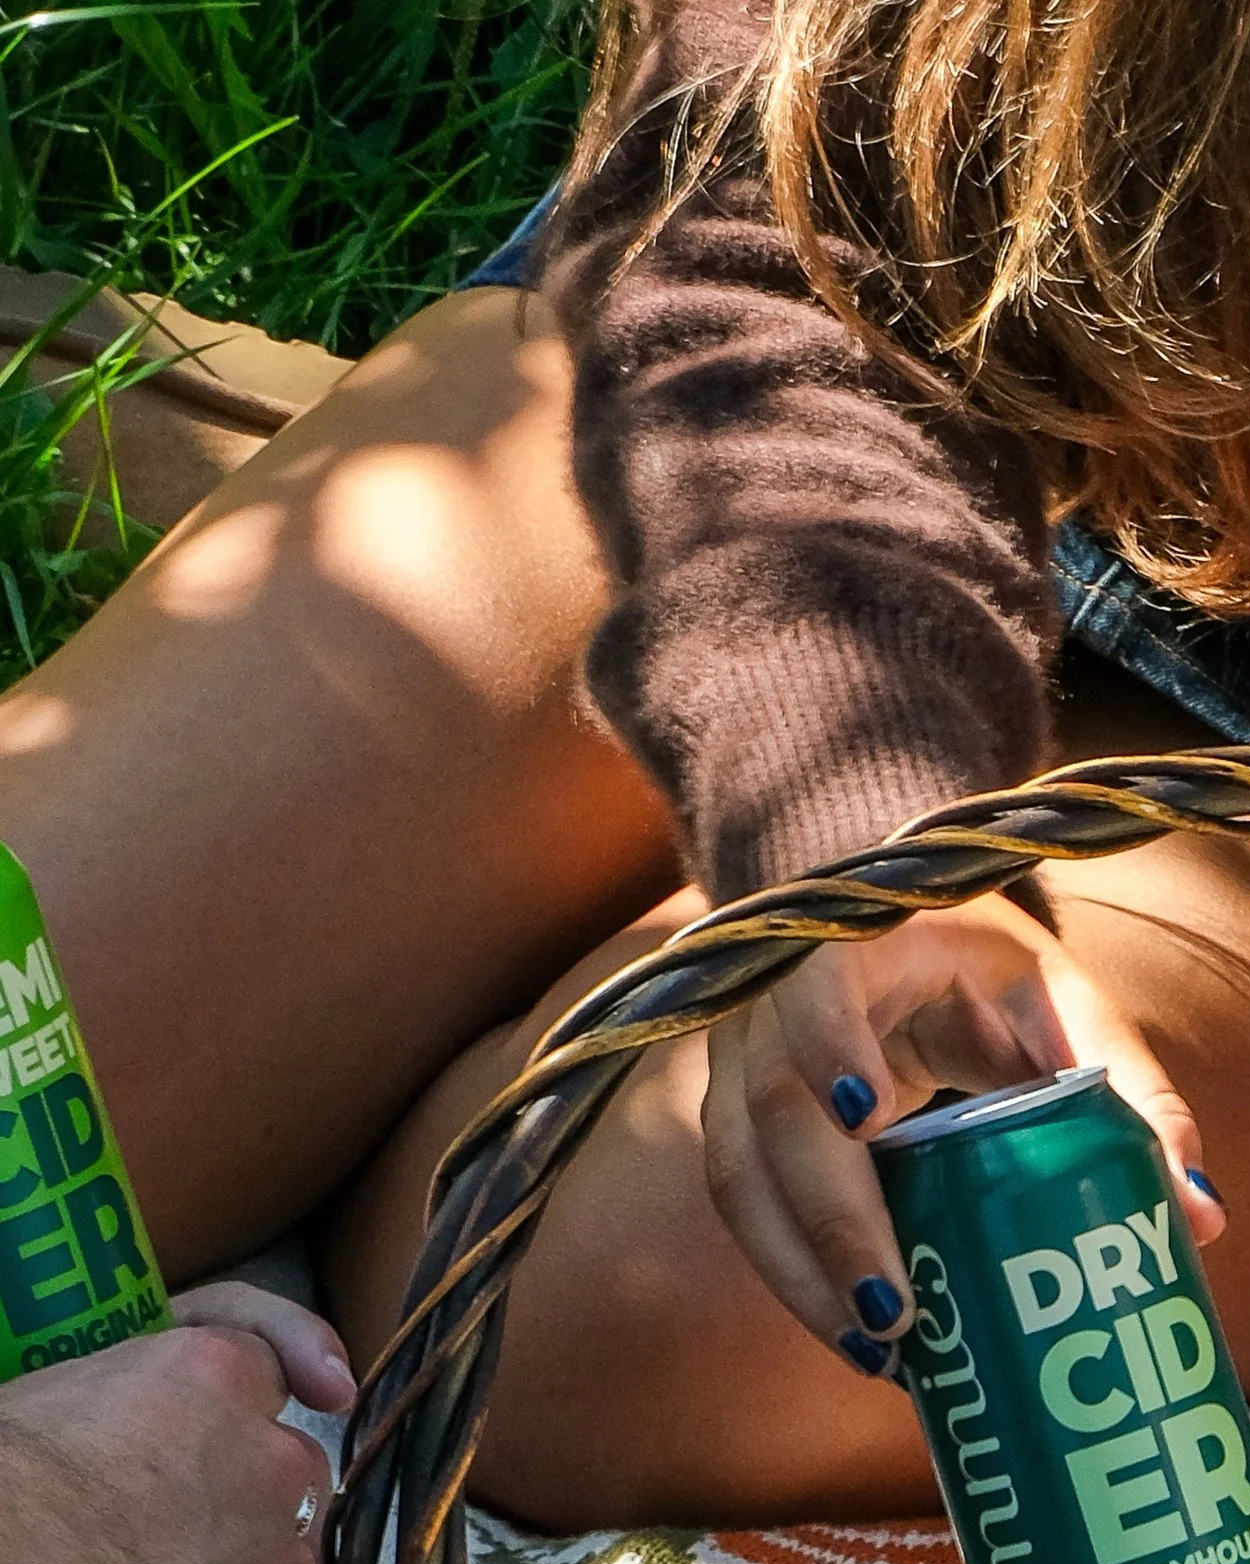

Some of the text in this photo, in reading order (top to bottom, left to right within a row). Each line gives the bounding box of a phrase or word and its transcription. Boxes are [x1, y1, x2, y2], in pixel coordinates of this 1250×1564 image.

[0, 1174, 150, 1339] ER
[1001, 1200, 1179, 1336] DRY
[20, 1287, 164, 1374] ORIGINAL
[1039, 1295, 1217, 1433] CID
